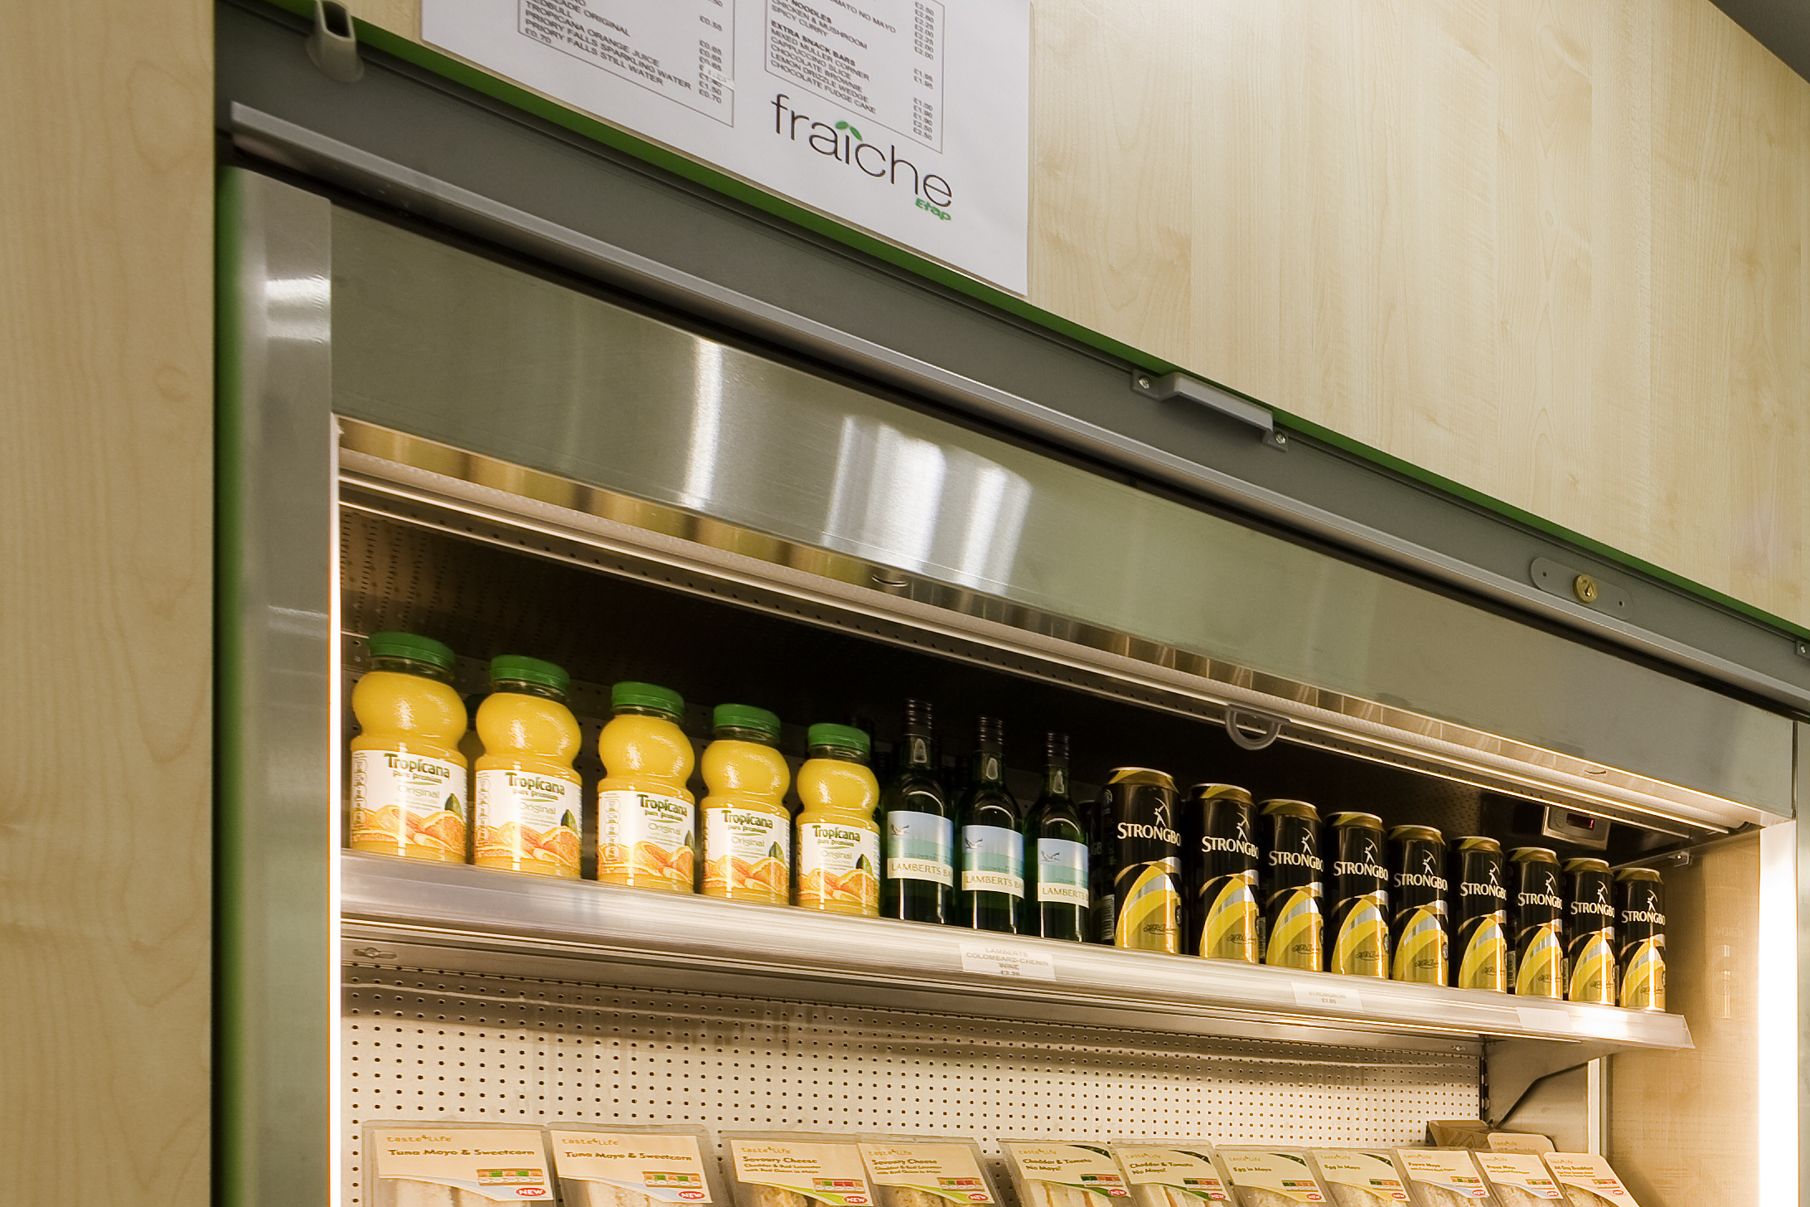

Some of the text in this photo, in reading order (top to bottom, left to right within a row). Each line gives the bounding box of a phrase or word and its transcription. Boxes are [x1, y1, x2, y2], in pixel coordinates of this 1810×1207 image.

[771, 3, 828, 37] SPICY CURRY
[819, 17, 868, 49] MUSHROOM
[859, 10, 896, 34] NO MAYO
[525, 9, 692, 90] PRIORY FALLS SPARKLING WATER
[525, 18, 664, 86] PRIORY FALLS STILL WATER
[587, 30, 630, 52] ORANGE
[771, 19, 856, 67] EXTRA SNACK BARS
[771, 27, 870, 81] MIXED MULLER CORNER
[771, 36, 853, 80] CAPPUCCINO SLICE
[771, 43, 863, 93] CHOCOLATE BROWNIE
[771, 51, 869, 103] LEMON DRIZZLE WEDGE
[771, 60, 877, 114] CHOCOLATE FUDGE CAKE
[915, 197, 952, 222] Etap
[384, 752, 450, 779] Tropicana
[505, 771, 565, 796] Tropicana
[636, 793, 688, 817] Tropicana
[721, 809, 773, 829] Tropicana
[812, 824, 861, 843] Tropicana
[891, 862, 942, 876] LAMBERTS
[966, 874, 1013, 888] LAMBERTS
[424, 1149, 458, 1157] Mayo
